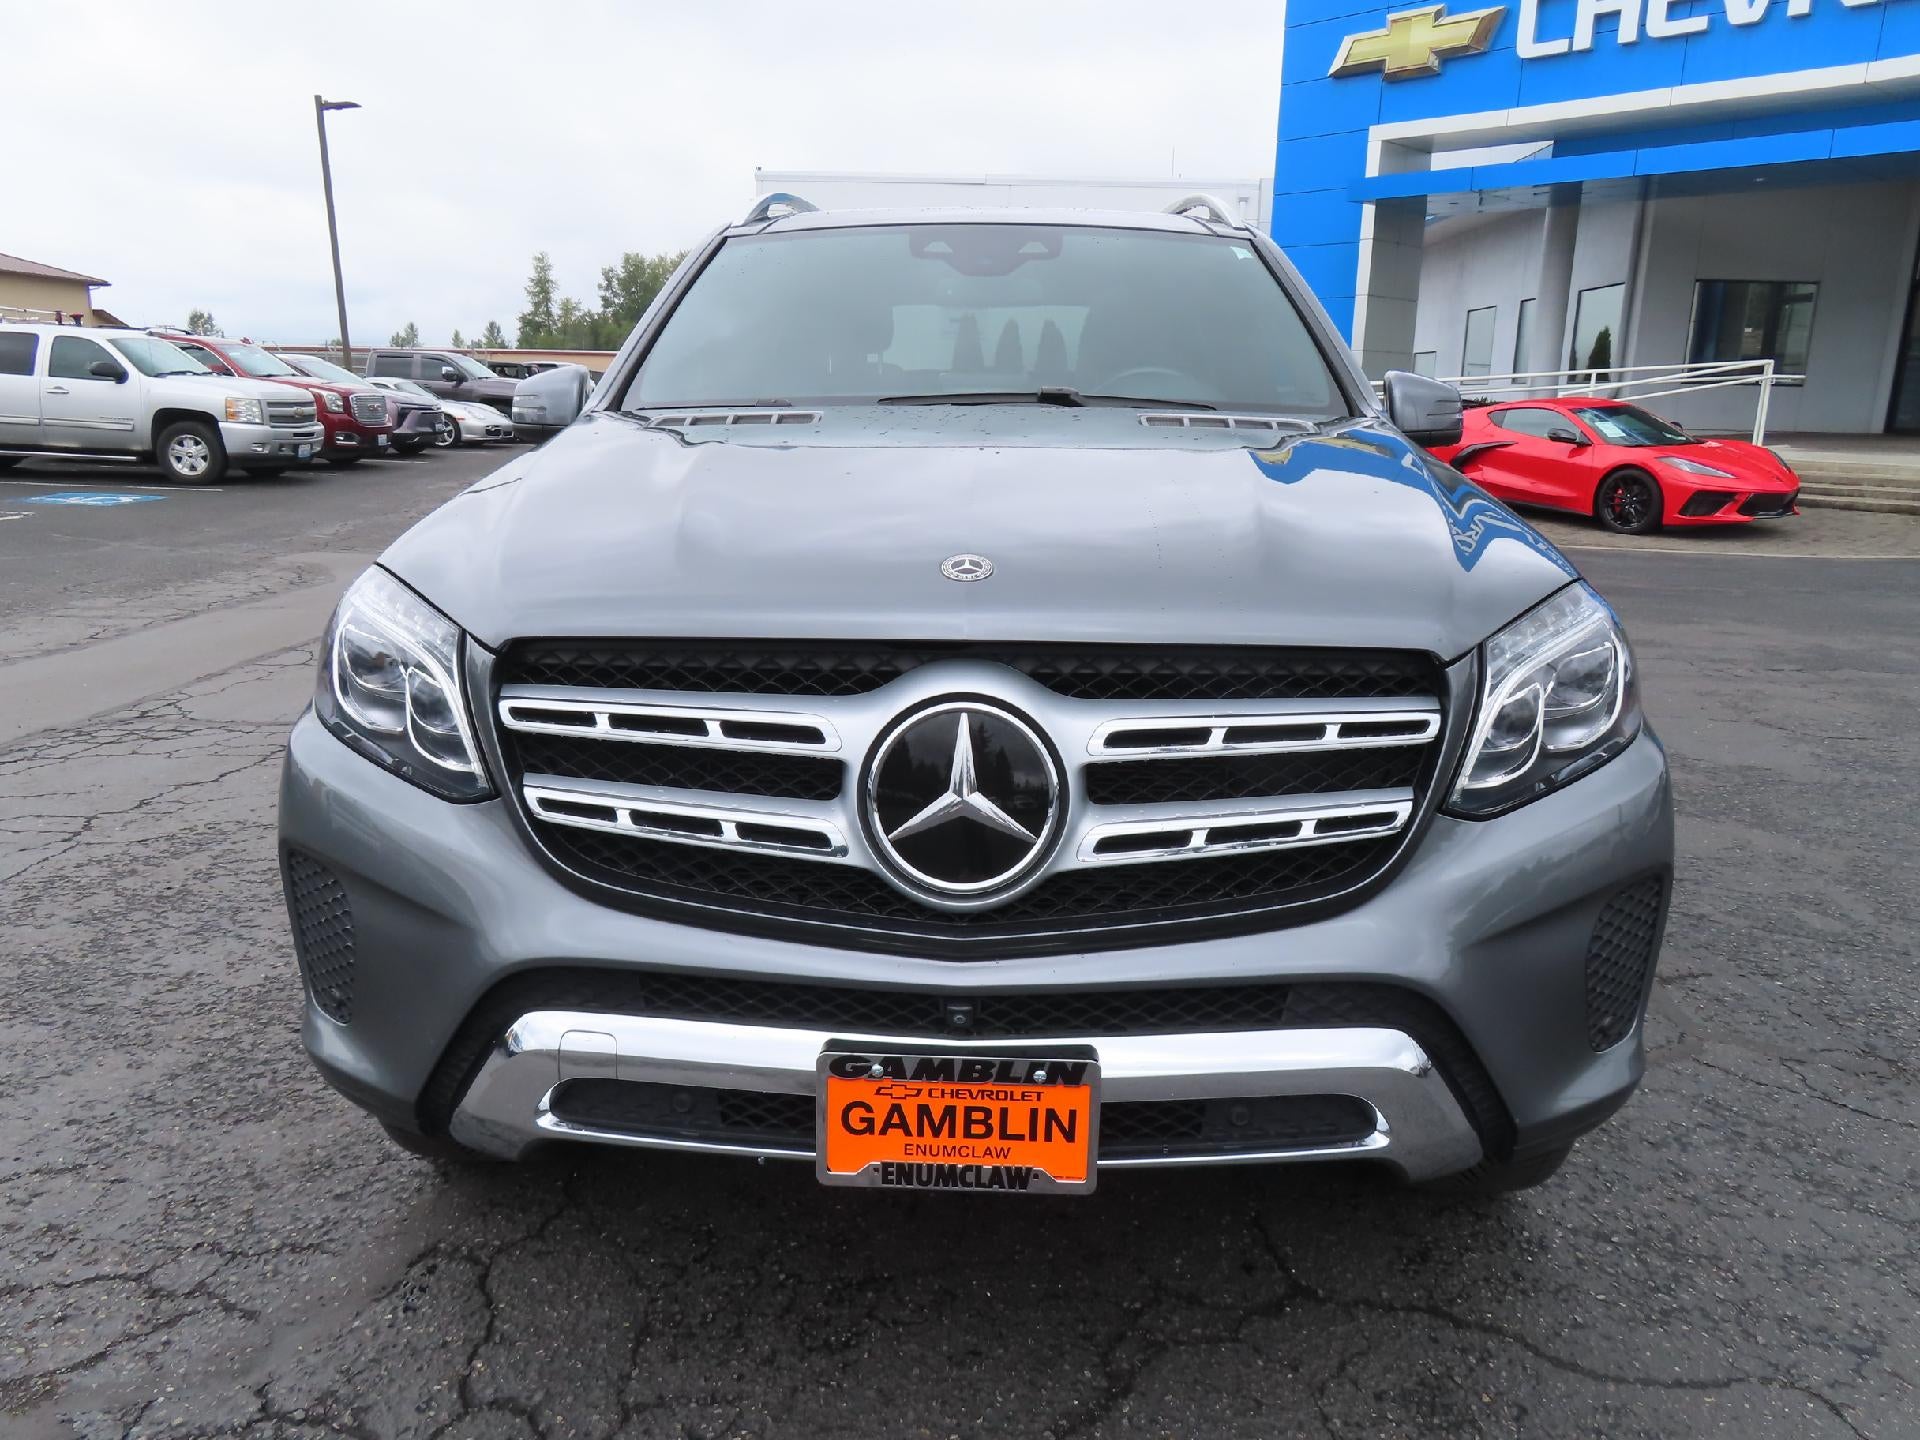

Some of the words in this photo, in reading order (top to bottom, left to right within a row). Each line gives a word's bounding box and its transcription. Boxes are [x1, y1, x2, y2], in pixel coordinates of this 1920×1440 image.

[829, 1055, 1088, 1086] GAMBLIN
[928, 1088, 1044, 1101] CHEVROLET
[841, 1100, 1077, 1143] GAMBLIN
[904, 1143, 1011, 1159] ENUMCLAW
[881, 1162, 1032, 1190] ENUMCLAW
